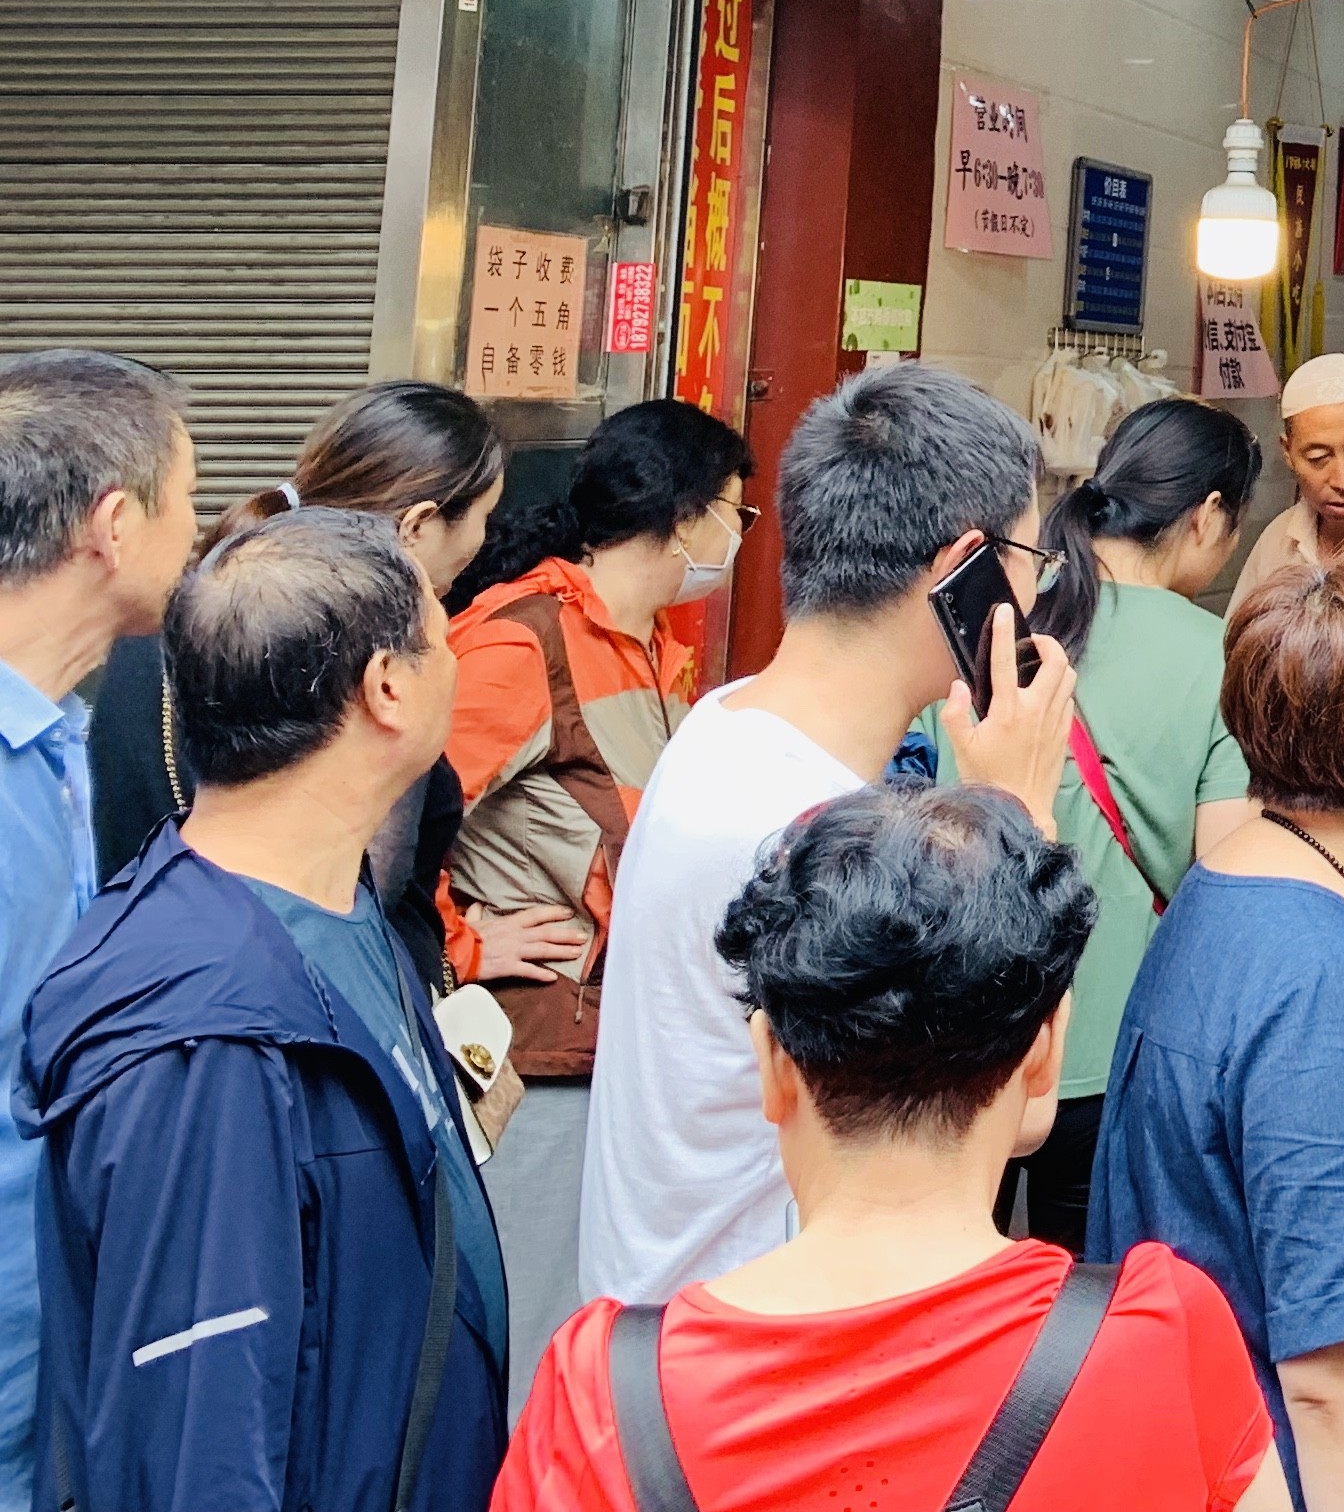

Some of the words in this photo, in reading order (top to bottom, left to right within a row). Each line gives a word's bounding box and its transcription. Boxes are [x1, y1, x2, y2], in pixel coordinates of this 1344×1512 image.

[487, 245, 574, 284] 袋子收费
[484, 296, 570, 330] 一个五角
[481, 342, 566, 393] 自备零钱
